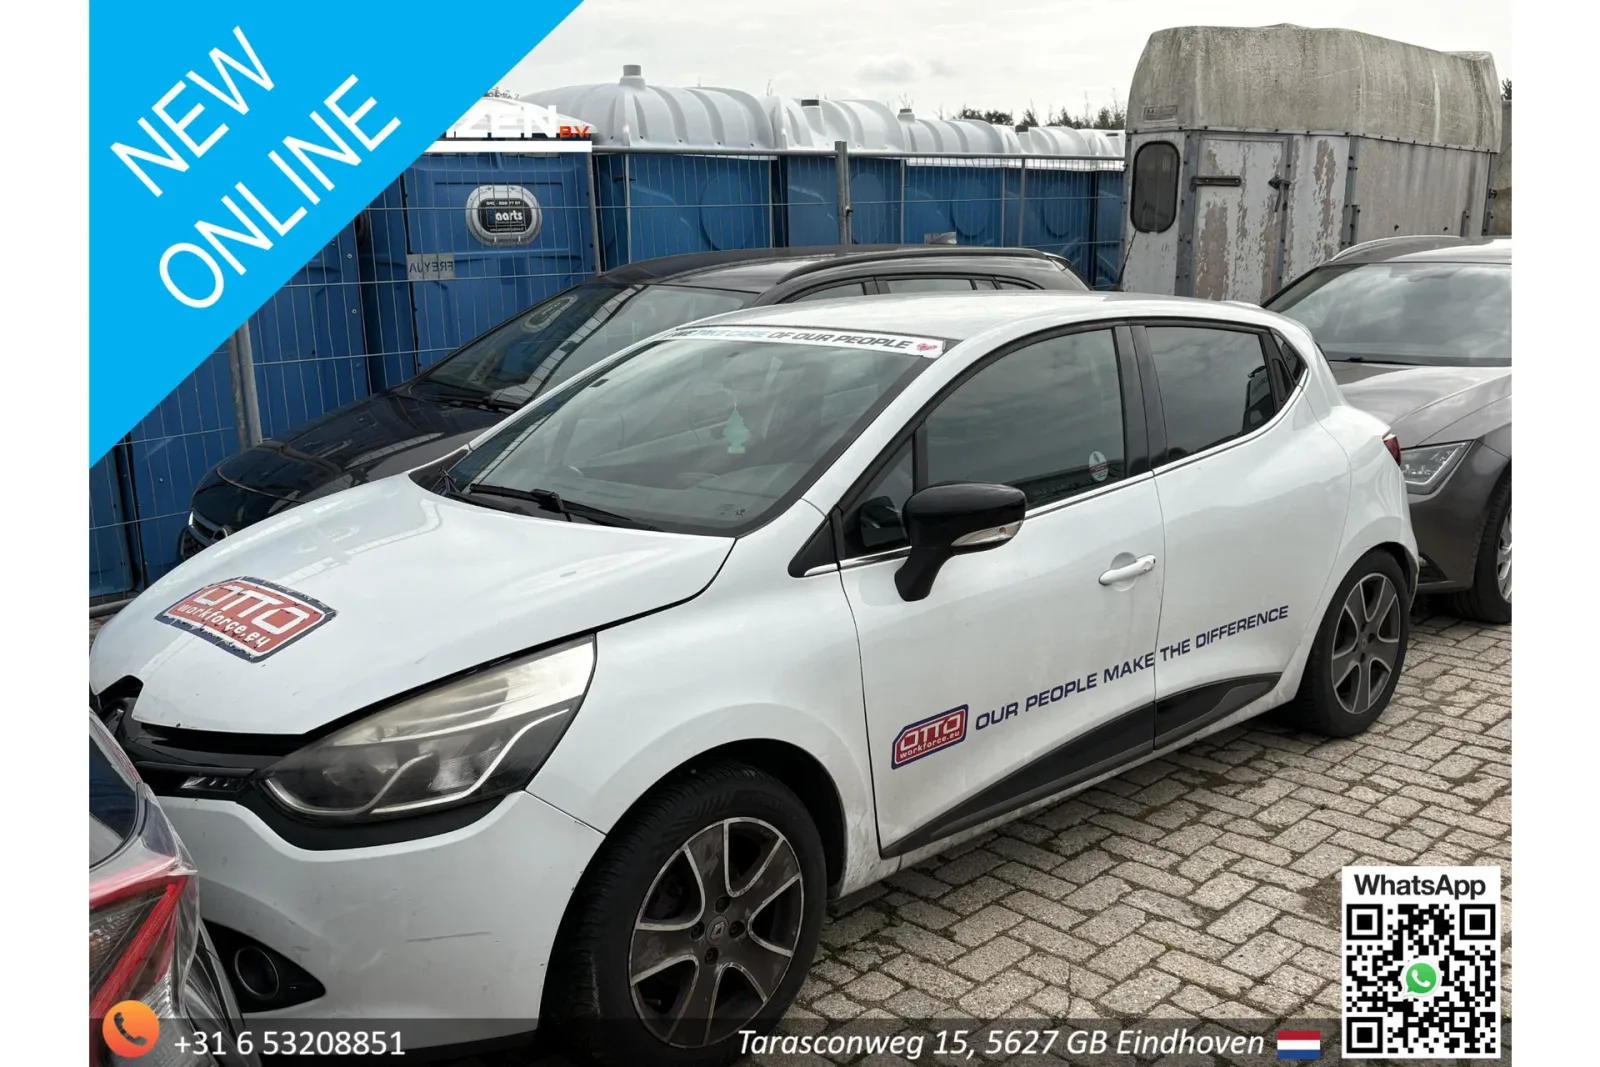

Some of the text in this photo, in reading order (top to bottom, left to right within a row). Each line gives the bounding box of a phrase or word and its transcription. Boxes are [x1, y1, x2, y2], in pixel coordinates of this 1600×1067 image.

[495, 210, 523, 221] aarts
[767, 331, 796, 339] OF
[792, 332, 835, 342] OUR
[832, 335, 914, 349] PEOPLE
[193, 585, 310, 635] OTTO
[975, 605, 1289, 730] OUR PEOPLE MAKE THE DIFFERENCE
[900, 714, 961, 752] OTTO
[900, 731, 960, 759] workforce.eu
